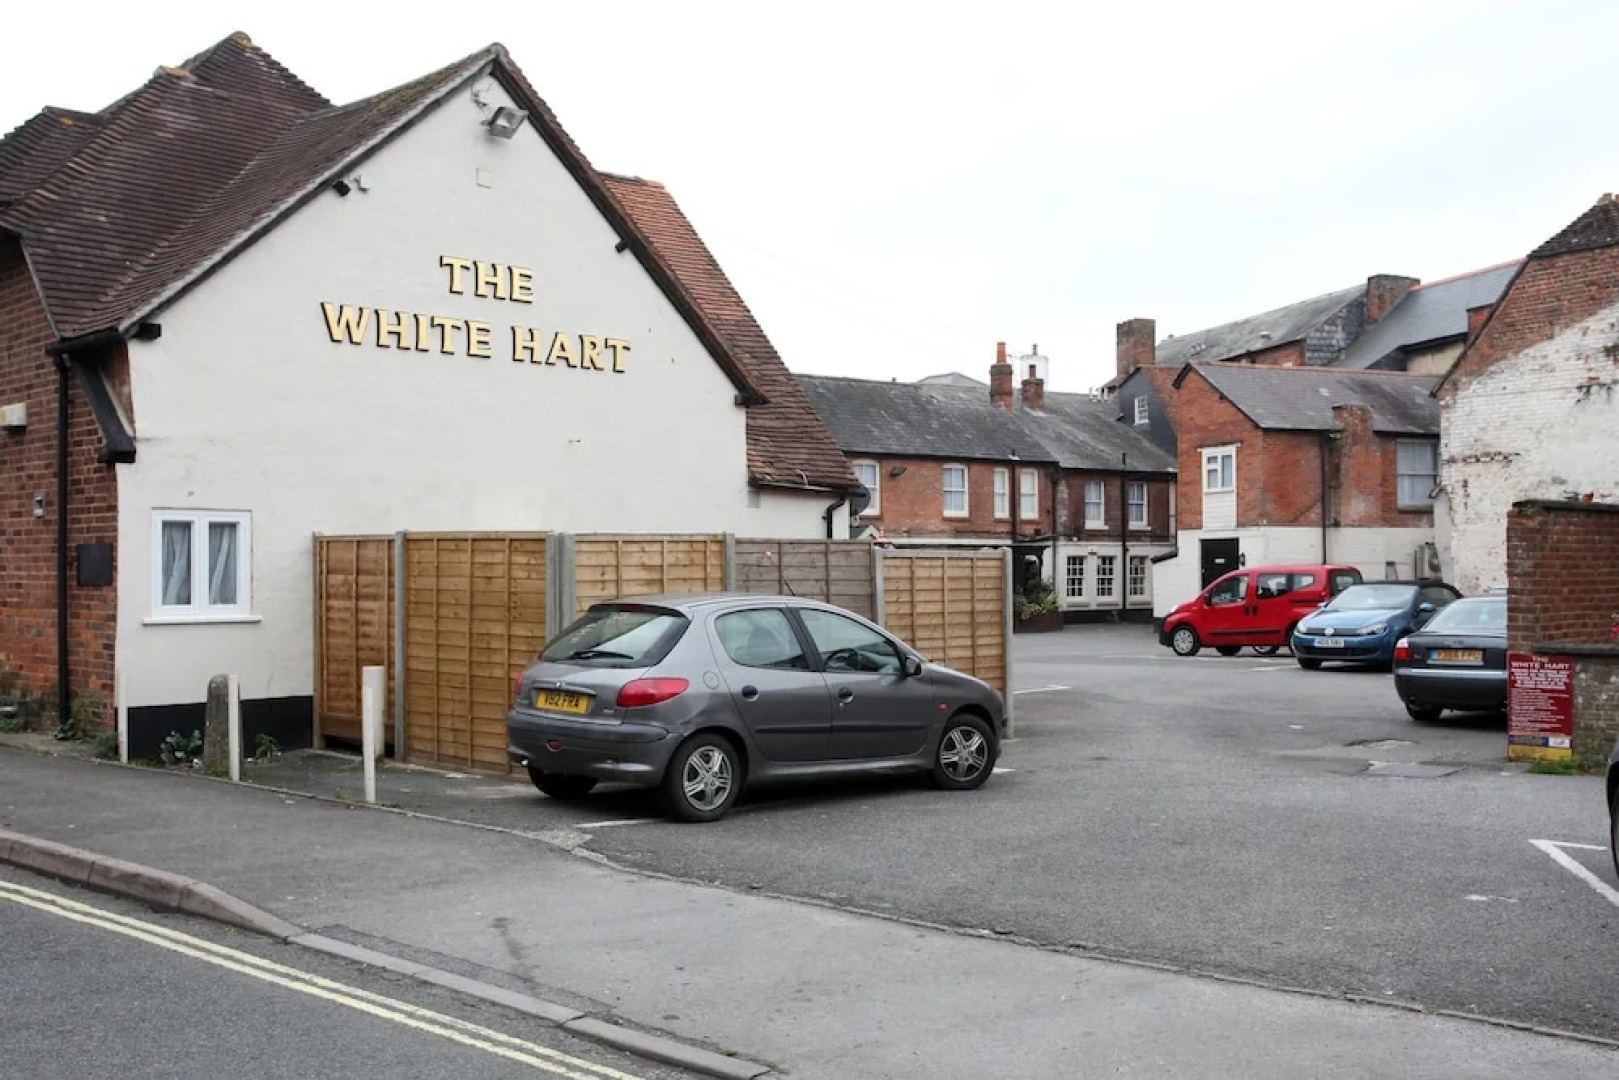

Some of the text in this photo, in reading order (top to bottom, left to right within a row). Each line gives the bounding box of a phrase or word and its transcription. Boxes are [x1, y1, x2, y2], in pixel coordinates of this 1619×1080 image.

[440, 255, 534, 304] THE
[321, 302, 631, 374] WHITE HART
